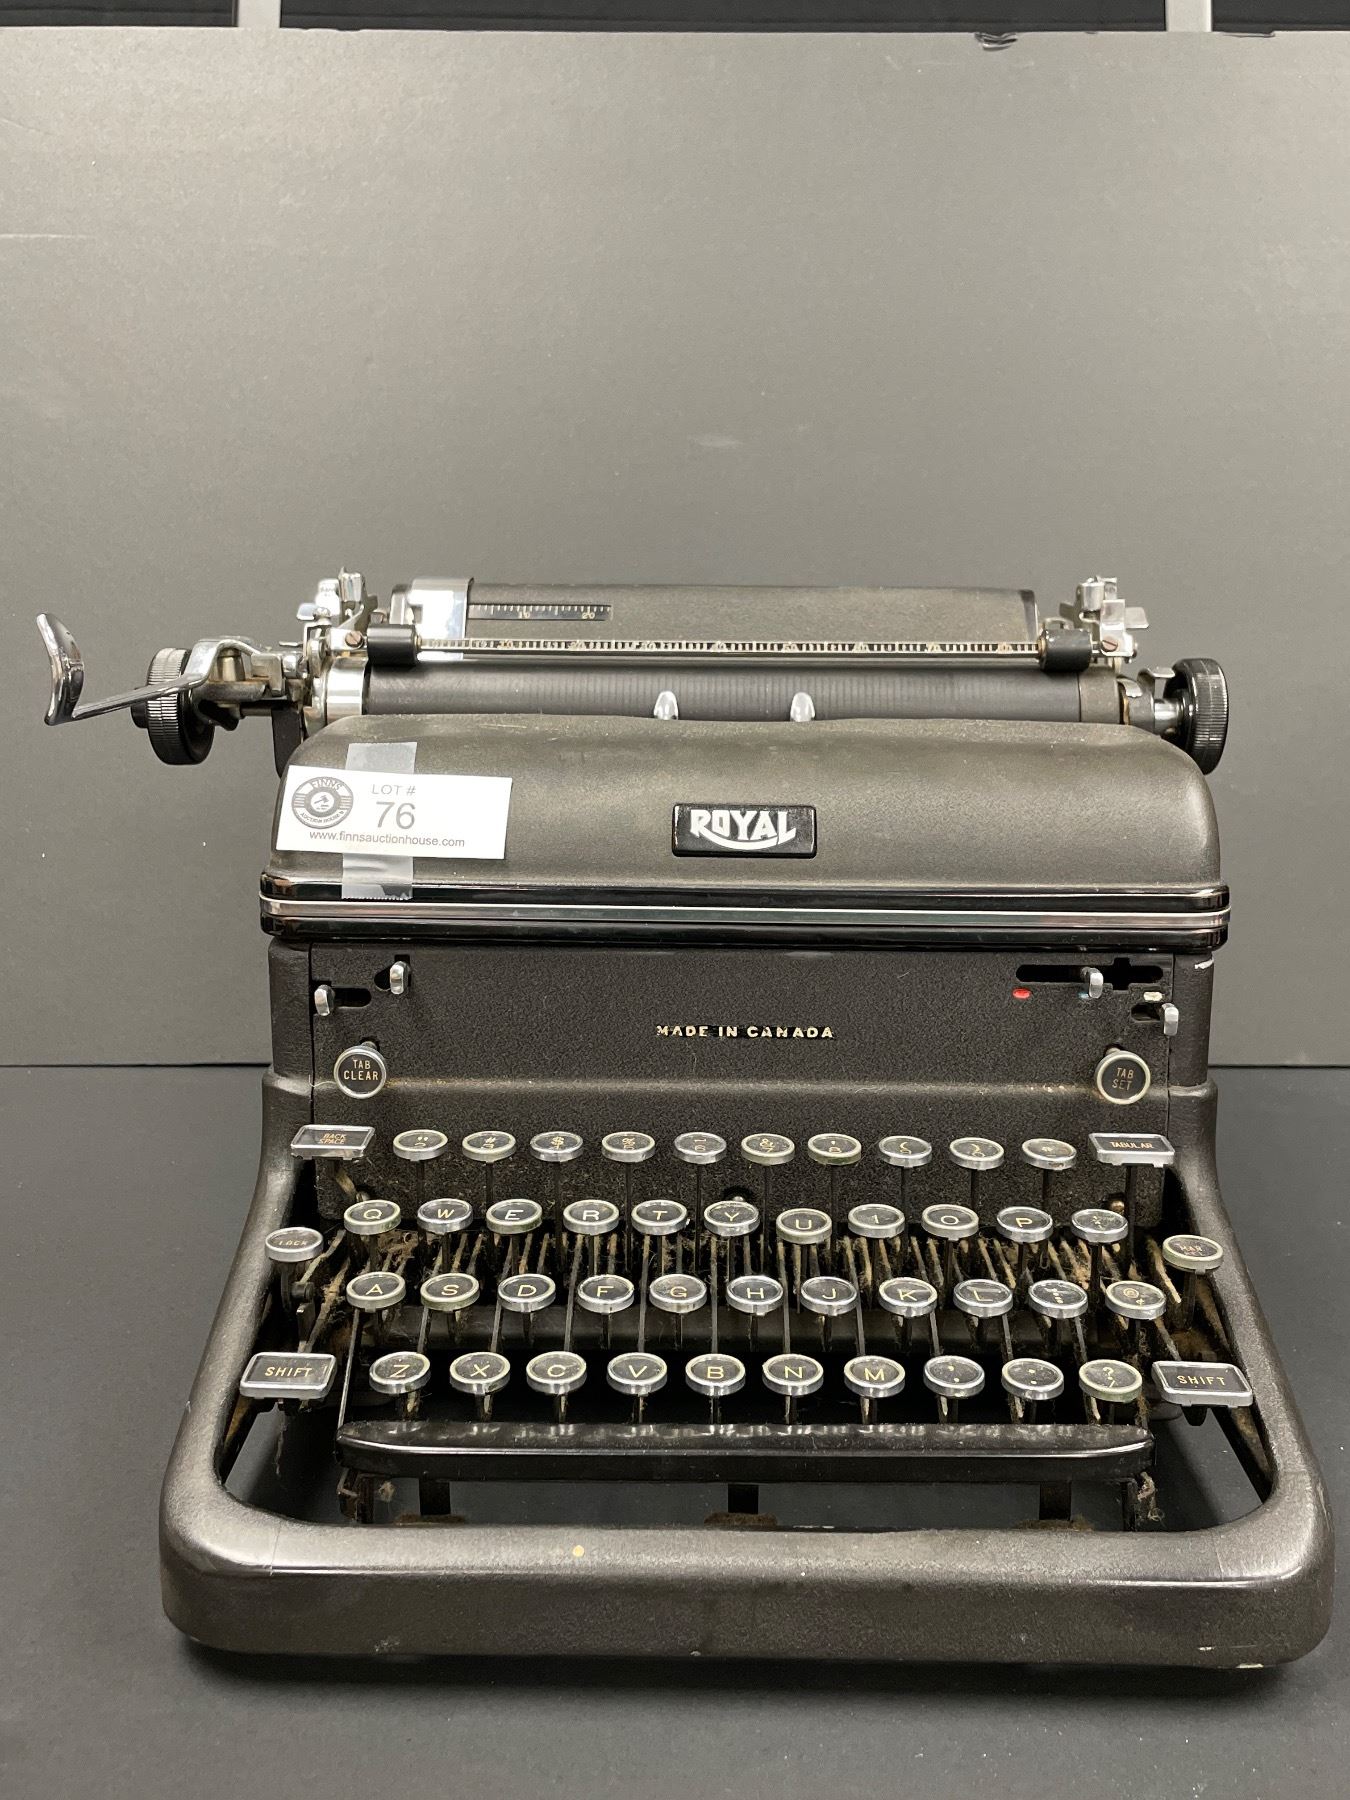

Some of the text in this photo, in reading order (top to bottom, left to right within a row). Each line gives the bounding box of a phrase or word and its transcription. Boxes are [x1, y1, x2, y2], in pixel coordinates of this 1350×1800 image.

[311, 777, 343, 792] FINNS
[371, 784, 417, 796] LOT #
[375, 801, 416, 830] 76
[690, 809, 797, 850] ROYAL
[309, 831, 465, 848] www.finnsauctionhouse.com
[656, 1025, 834, 1039] MADE IN CANADA
[352, 1059, 371, 1070] TAB
[343, 1070, 379, 1081] CLEAR
[1116, 1067, 1135, 1079] TAB
[1111, 1078, 1133, 1091] SET
[1110, 1141, 1154, 1149] TABULAR
[363, 1209, 383, 1220] Q
[437, 1208, 455, 1219] W
[504, 1209, 524, 1221] E
[582, 1210, 600, 1221] R
[652, 1210, 668, 1220] T
[724, 1211, 740, 1222] Y
[795, 1219, 812, 1230] U
[1015, 1216, 1033, 1227] P
[365, 1283, 383, 1295] A
[441, 1284, 459, 1296] S
[517, 1284, 537, 1297] D
[596, 1285, 615, 1297] F
[669, 1286, 687, 1298] G
[746, 1287, 765, 1299] H
[821, 1287, 837, 1300] J
[899, 1289, 918, 1301] K
[973, 1290, 994, 1302] L
[264, 1366, 312, 1378] SHIFT
[389, 1364, 411, 1378] Z
[470, 1364, 490, 1377] X
[547, 1364, 566, 1378] C
[628, 1364, 648, 1378] V
[707, 1366, 725, 1379] B
[784, 1365, 803, 1379] N
[864, 1367, 885, 1381] M
[1176, 1375, 1226, 1386] SHIFT
